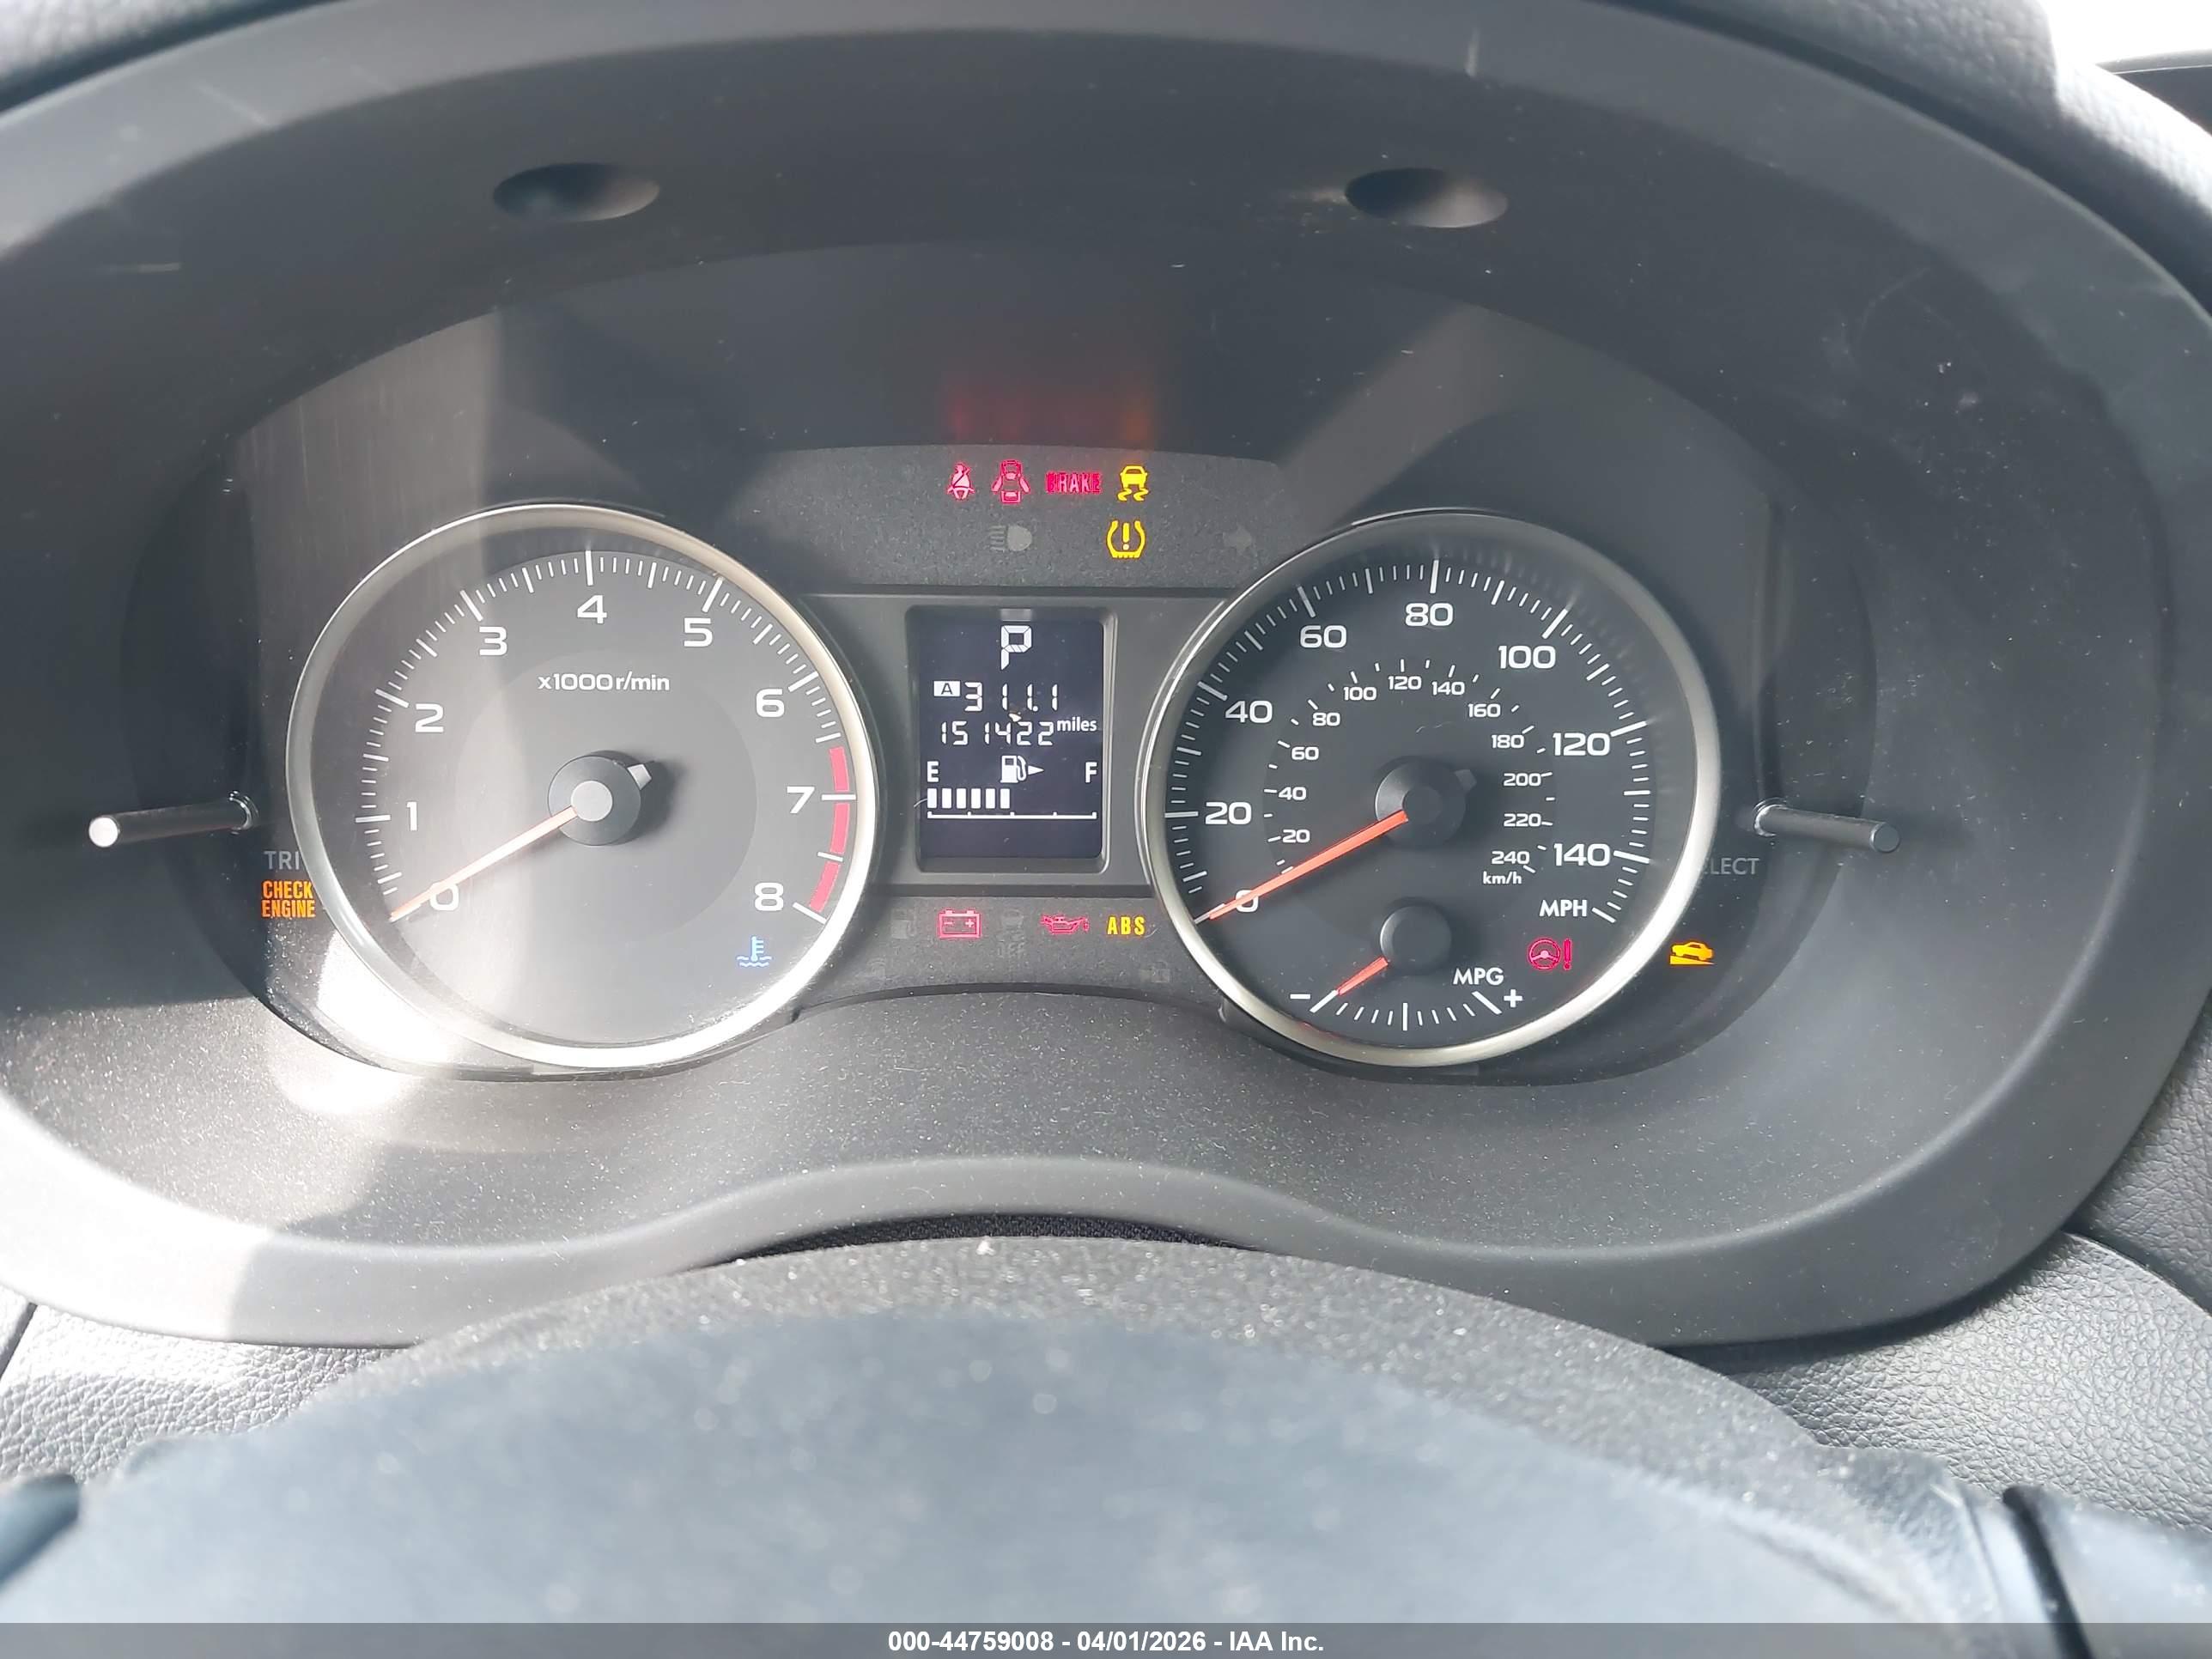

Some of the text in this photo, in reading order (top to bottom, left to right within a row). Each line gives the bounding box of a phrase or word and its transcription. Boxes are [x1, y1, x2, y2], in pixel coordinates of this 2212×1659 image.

[577, 594, 607, 624] 4
[1405, 602, 1454, 627] 80
[478, 626, 507, 656] 3
[684, 617, 713, 647] 5
[1300, 625, 1347, 648] 60
[1000, 624, 1032, 671] P
[1498, 645, 1556, 669] 100
[538, 671, 670, 690] x1000 r/min
[1388, 676, 1422, 690] 120
[1431, 681, 1465, 696] 140
[756, 688, 785, 718] 6
[964, 682, 1058, 712] 311.1
[1343, 686, 1377, 701] 100
[415, 703, 444, 732] 2
[1224, 701, 1273, 724] 40
[1312, 712, 1340, 726] 80
[1468, 703, 1501, 718] 160
[941, 716, 1097, 746] 151422 miles
[1491, 734, 1524, 749] 180
[1291, 746, 1320, 761] 60
[1553, 732, 1610, 757] 120
[927, 761, 940, 782] E
[1085, 762, 1097, 783] F
[1504, 773, 1541, 787] 200
[787, 786, 815, 814] 7
[1278, 787, 1307, 801] 40
[406, 801, 417, 831] 1
[1205, 801, 1252, 825] 20
[1503, 813, 1541, 827] 220
[1282, 829, 1310, 843] 20
[264, 850, 300, 871] TRI
[1491, 850, 1530, 865] 240
[1553, 842, 1611, 866] 140
[1703, 857, 1759, 875] LECT
[1482, 871, 1522, 884] km/h
[263, 880, 314, 899] CHECK
[429, 881, 459, 912] 0
[754, 882, 784, 912] 8
[261, 900, 316, 919] ENGINE
[1235, 888, 1259, 913] 0
[1539, 899, 1588, 917] MPH
[1107, 915, 1146, 935] ABS
[1453, 967, 1504, 986] MPG
